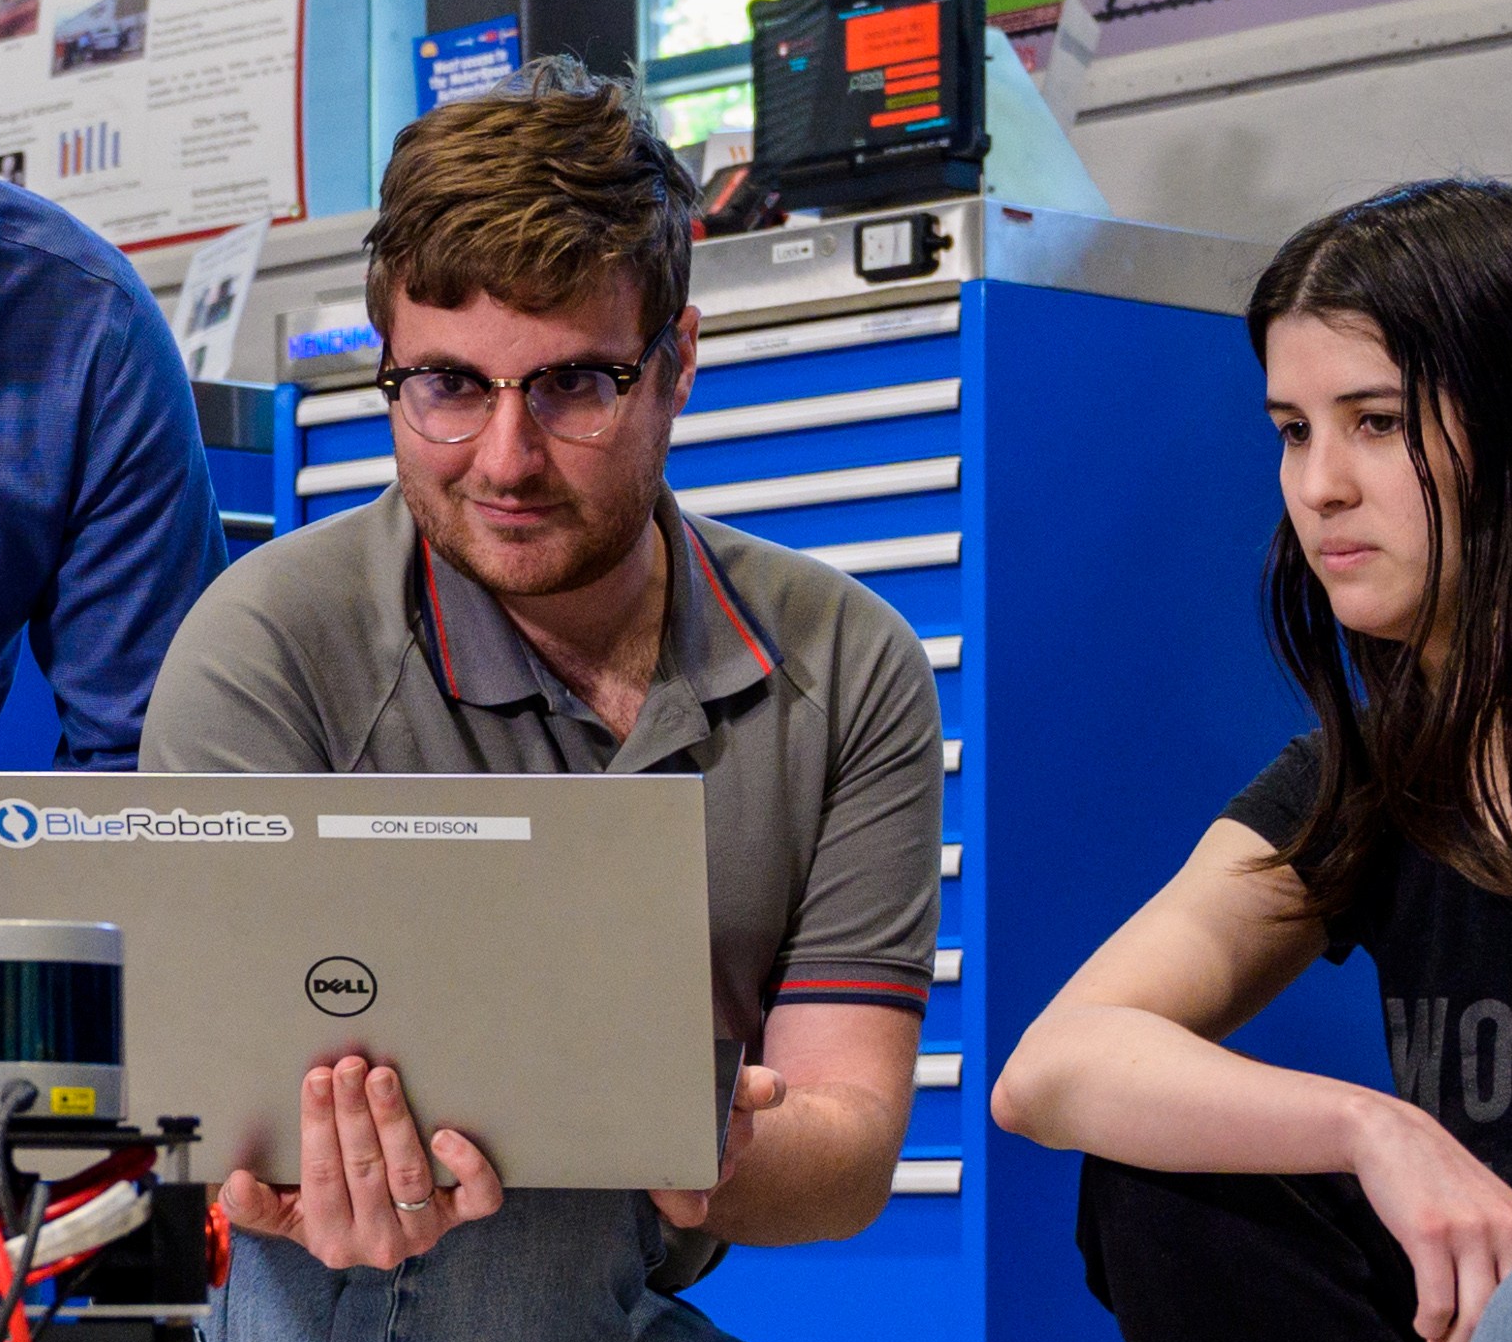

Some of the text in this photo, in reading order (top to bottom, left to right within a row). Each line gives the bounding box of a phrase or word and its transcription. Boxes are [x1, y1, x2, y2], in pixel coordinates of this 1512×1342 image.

[46, 812, 288, 837] BlueRobotics
[371, 820, 478, 835] CON EDISON
[313, 977, 370, 994] DELL
